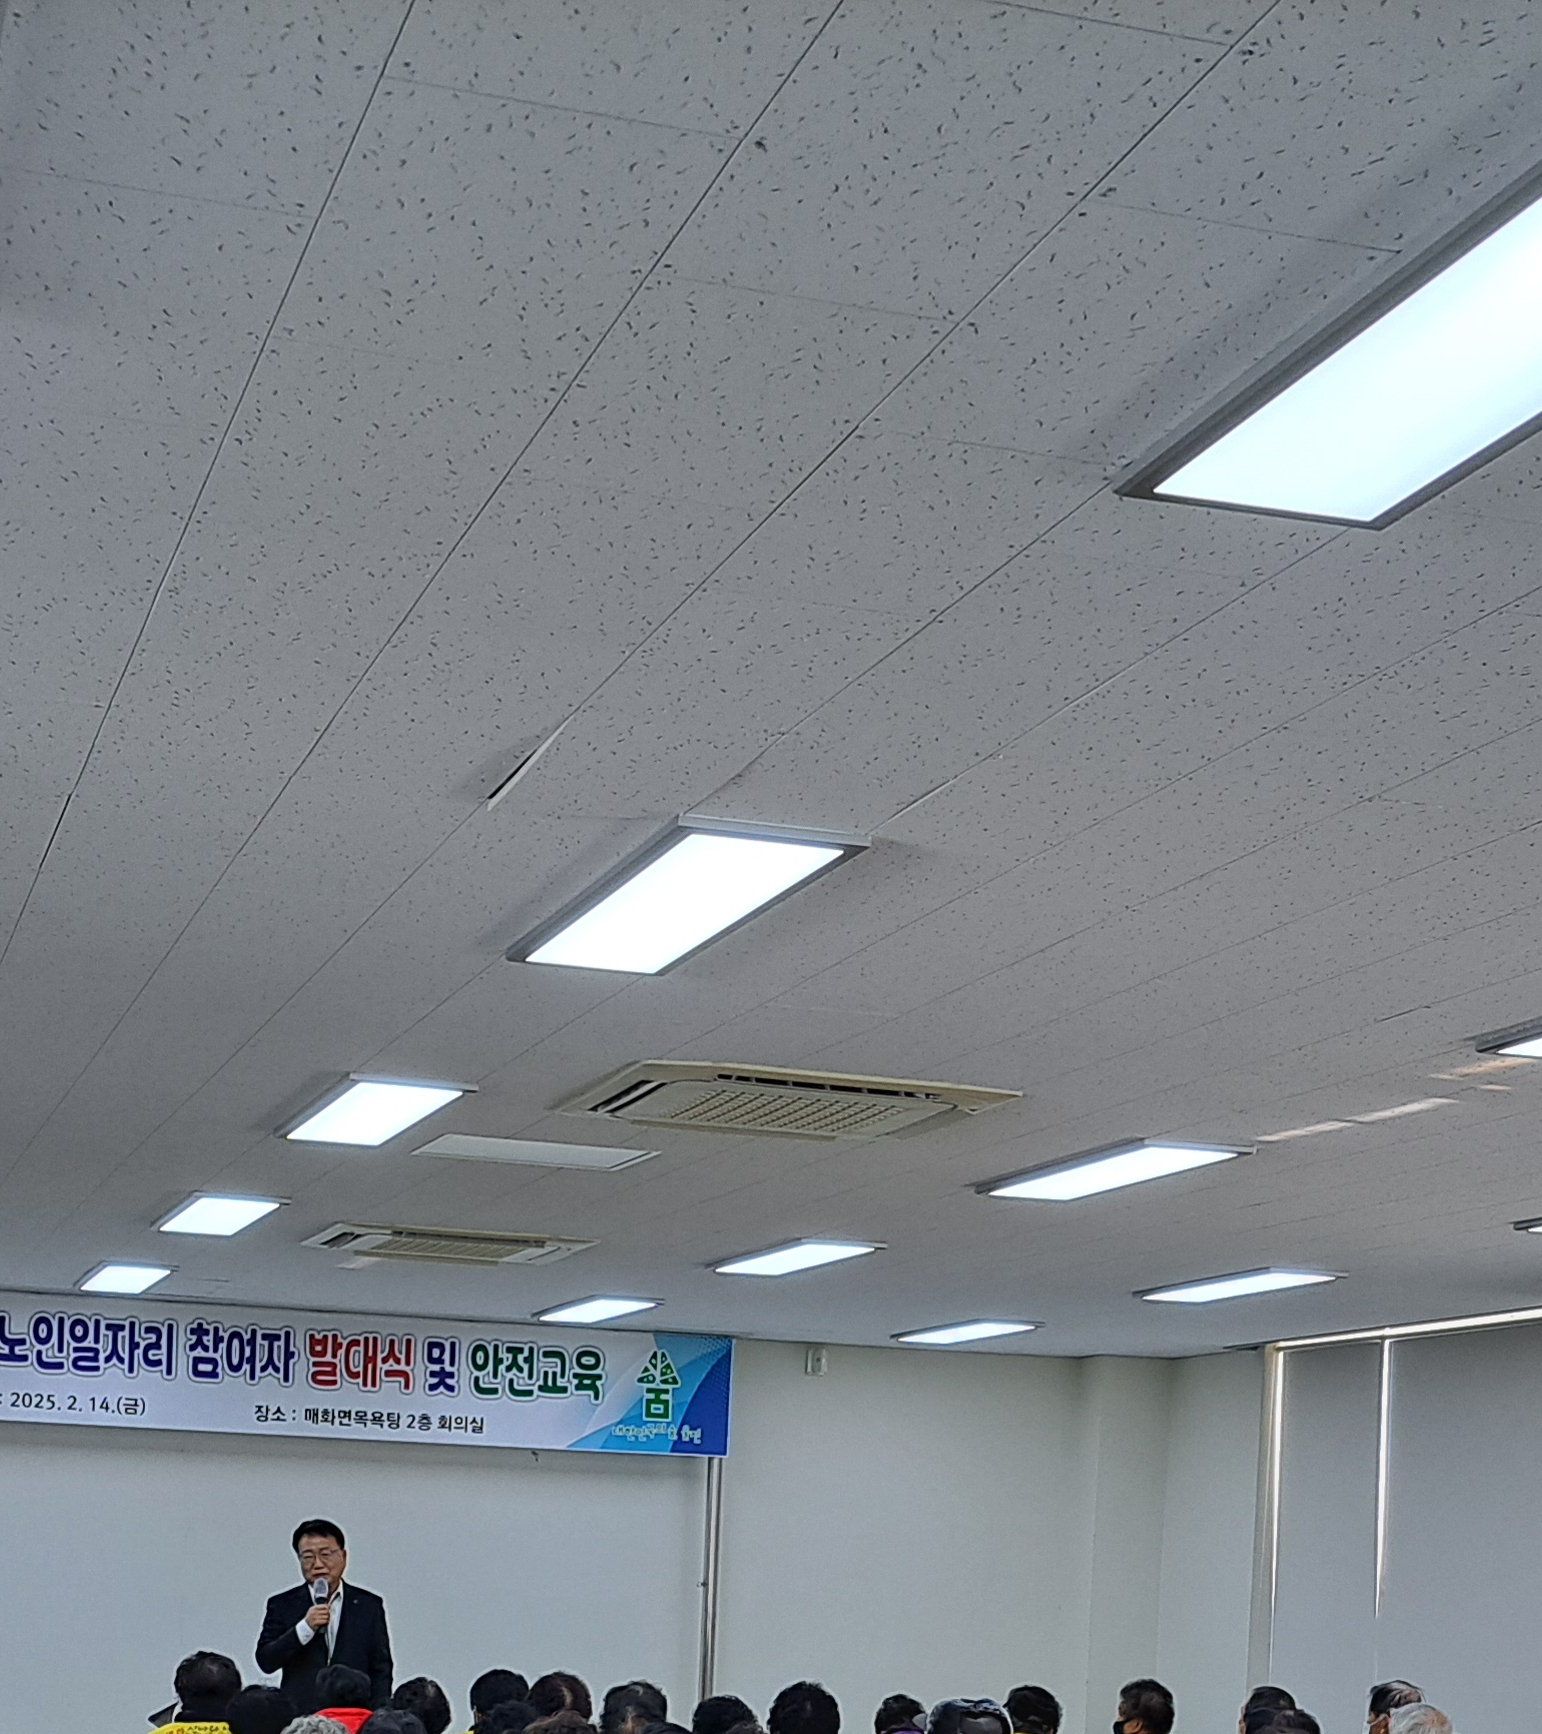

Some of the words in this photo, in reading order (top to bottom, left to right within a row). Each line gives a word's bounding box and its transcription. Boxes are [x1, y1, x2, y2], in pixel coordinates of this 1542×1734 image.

[185, 1320, 297, 1385] 참여자
[306, 1330, 415, 1392] 발대식
[425, 1338, 459, 1396] 및
[469, 1340, 606, 1402] 안전교육
[303, 1407, 401, 1430] 매화면목욕탕
[405, 1413, 433, 1431] 2층
[437, 1415, 486, 1435] 회의실
